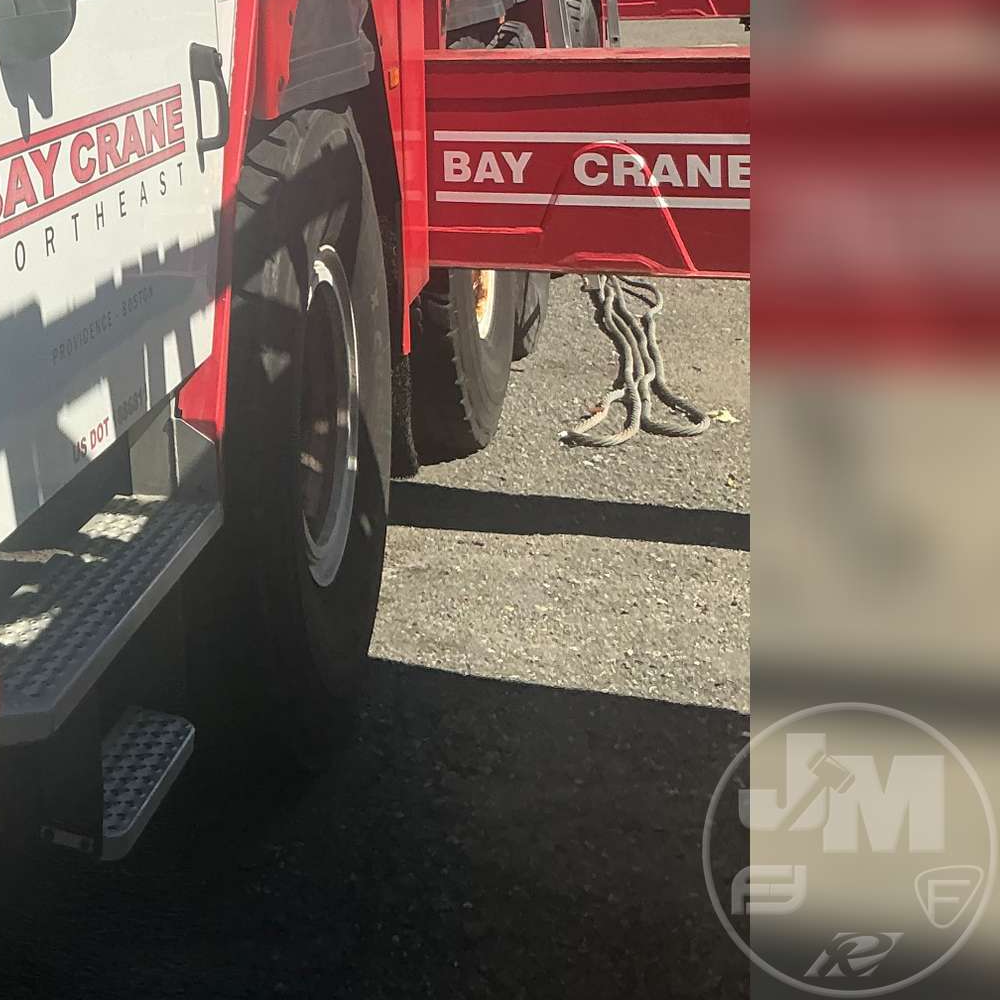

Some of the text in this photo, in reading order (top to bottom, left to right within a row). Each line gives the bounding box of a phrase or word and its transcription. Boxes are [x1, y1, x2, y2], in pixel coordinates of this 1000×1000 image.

[69, 96, 185, 184] CRANE
[442, 150, 751, 189] BAY CRANE
[72, 415, 110, 465] US DOT
